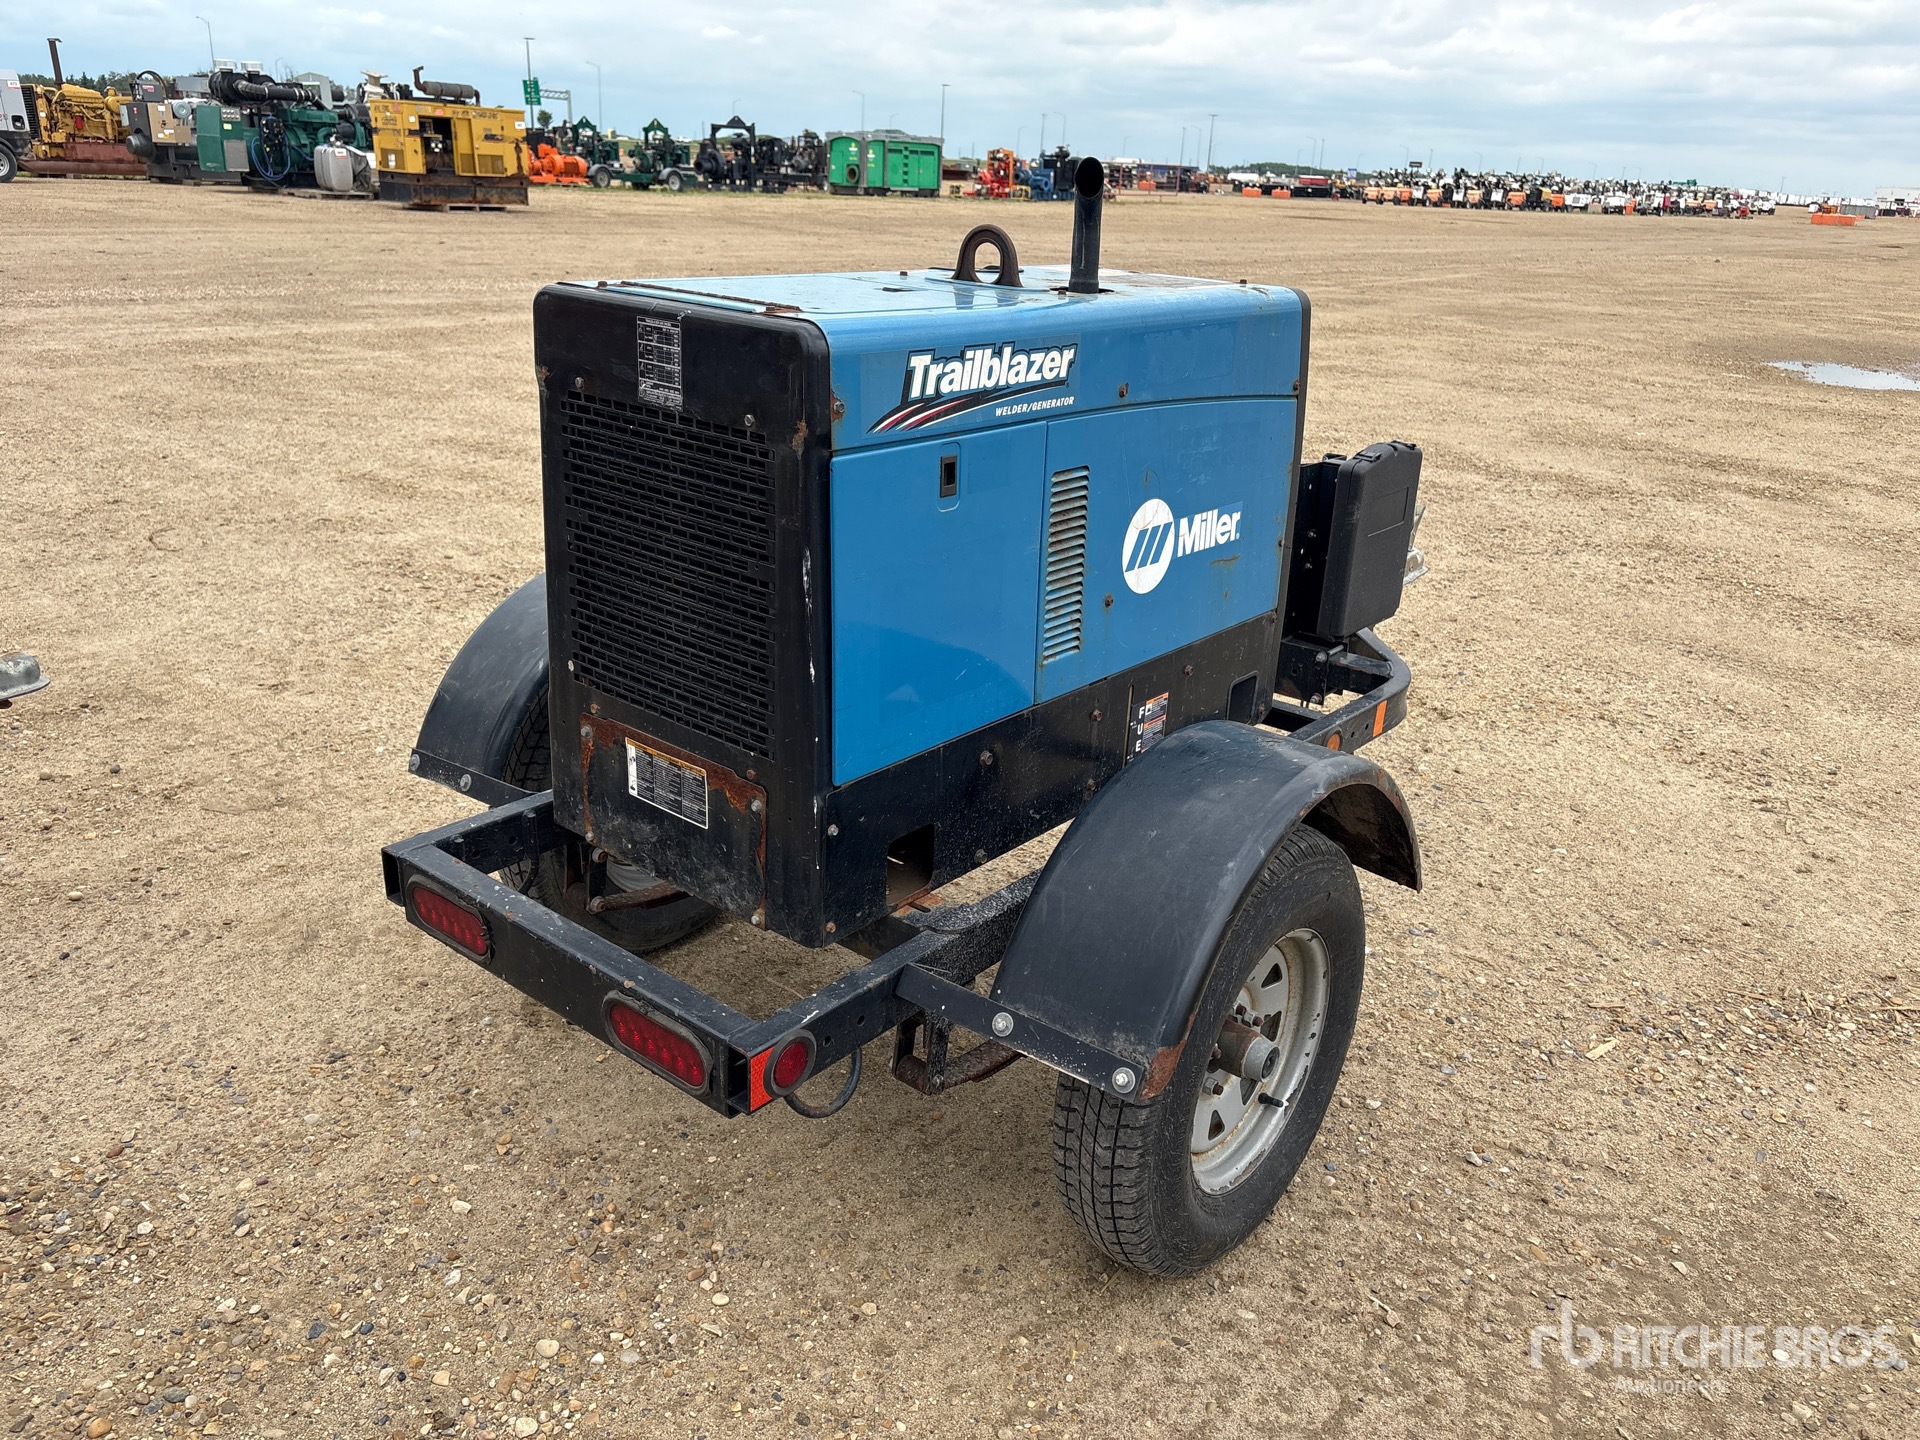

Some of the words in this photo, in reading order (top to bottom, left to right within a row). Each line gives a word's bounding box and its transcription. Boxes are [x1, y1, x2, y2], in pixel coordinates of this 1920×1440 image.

[908, 345, 1077, 399] Trailblazer
[995, 396, 1075, 417] WELDER/GENERATOR
[1177, 508, 1241, 558] Miller
[1135, 706, 1145, 752] FUE
